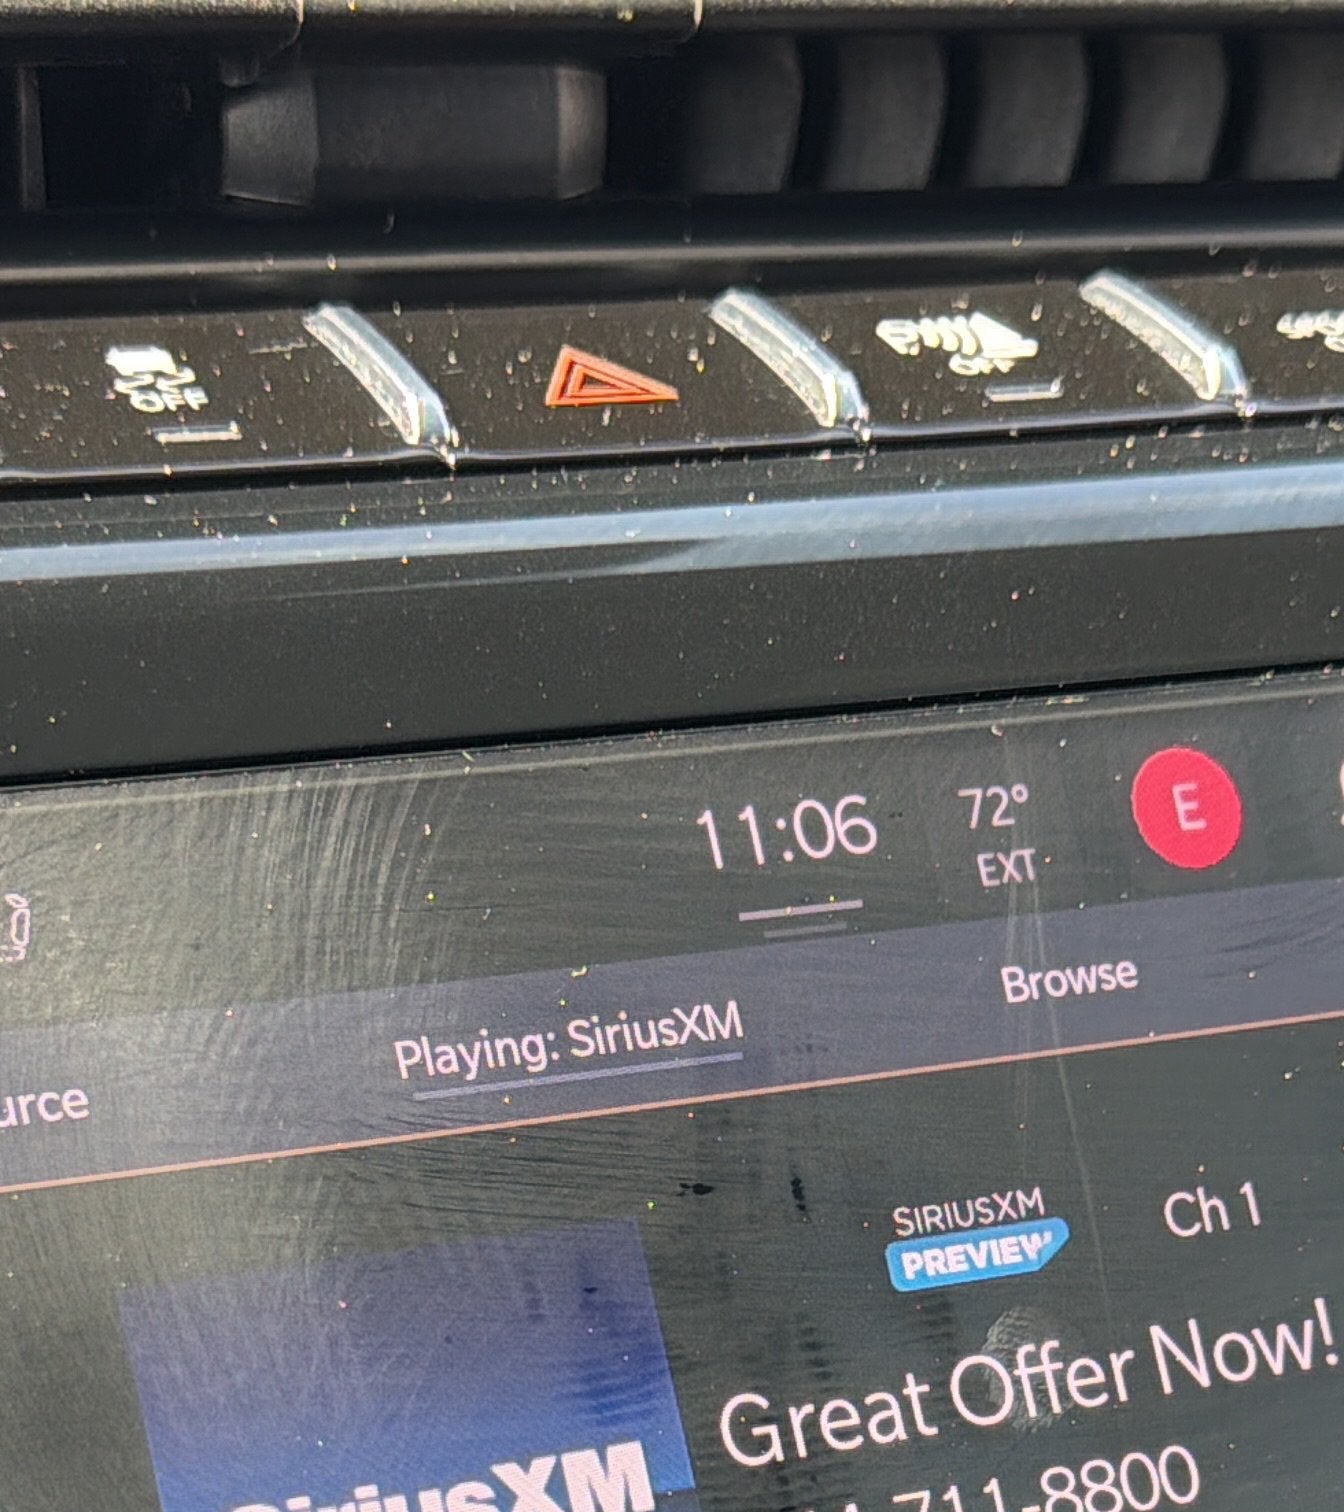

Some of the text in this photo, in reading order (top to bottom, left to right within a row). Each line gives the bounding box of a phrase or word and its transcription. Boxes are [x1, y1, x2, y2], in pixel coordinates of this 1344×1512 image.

[130, 387, 209, 413] OFF
[696, 795, 879, 870] 11:06
[1172, 783, 1208, 832] E
[977, 848, 1038, 888] EXT
[1001, 958, 1139, 1004] Browse
[392, 1000, 745, 1081] Playing: SiriusXM
[892, 1186, 1046, 1237] SIRIUSXM
[1164, 1181, 1263, 1237] Ch 1
[901, 1230, 1053, 1280] PREVIEW
[719, 1297, 1340, 1467] Great Offer Now!
